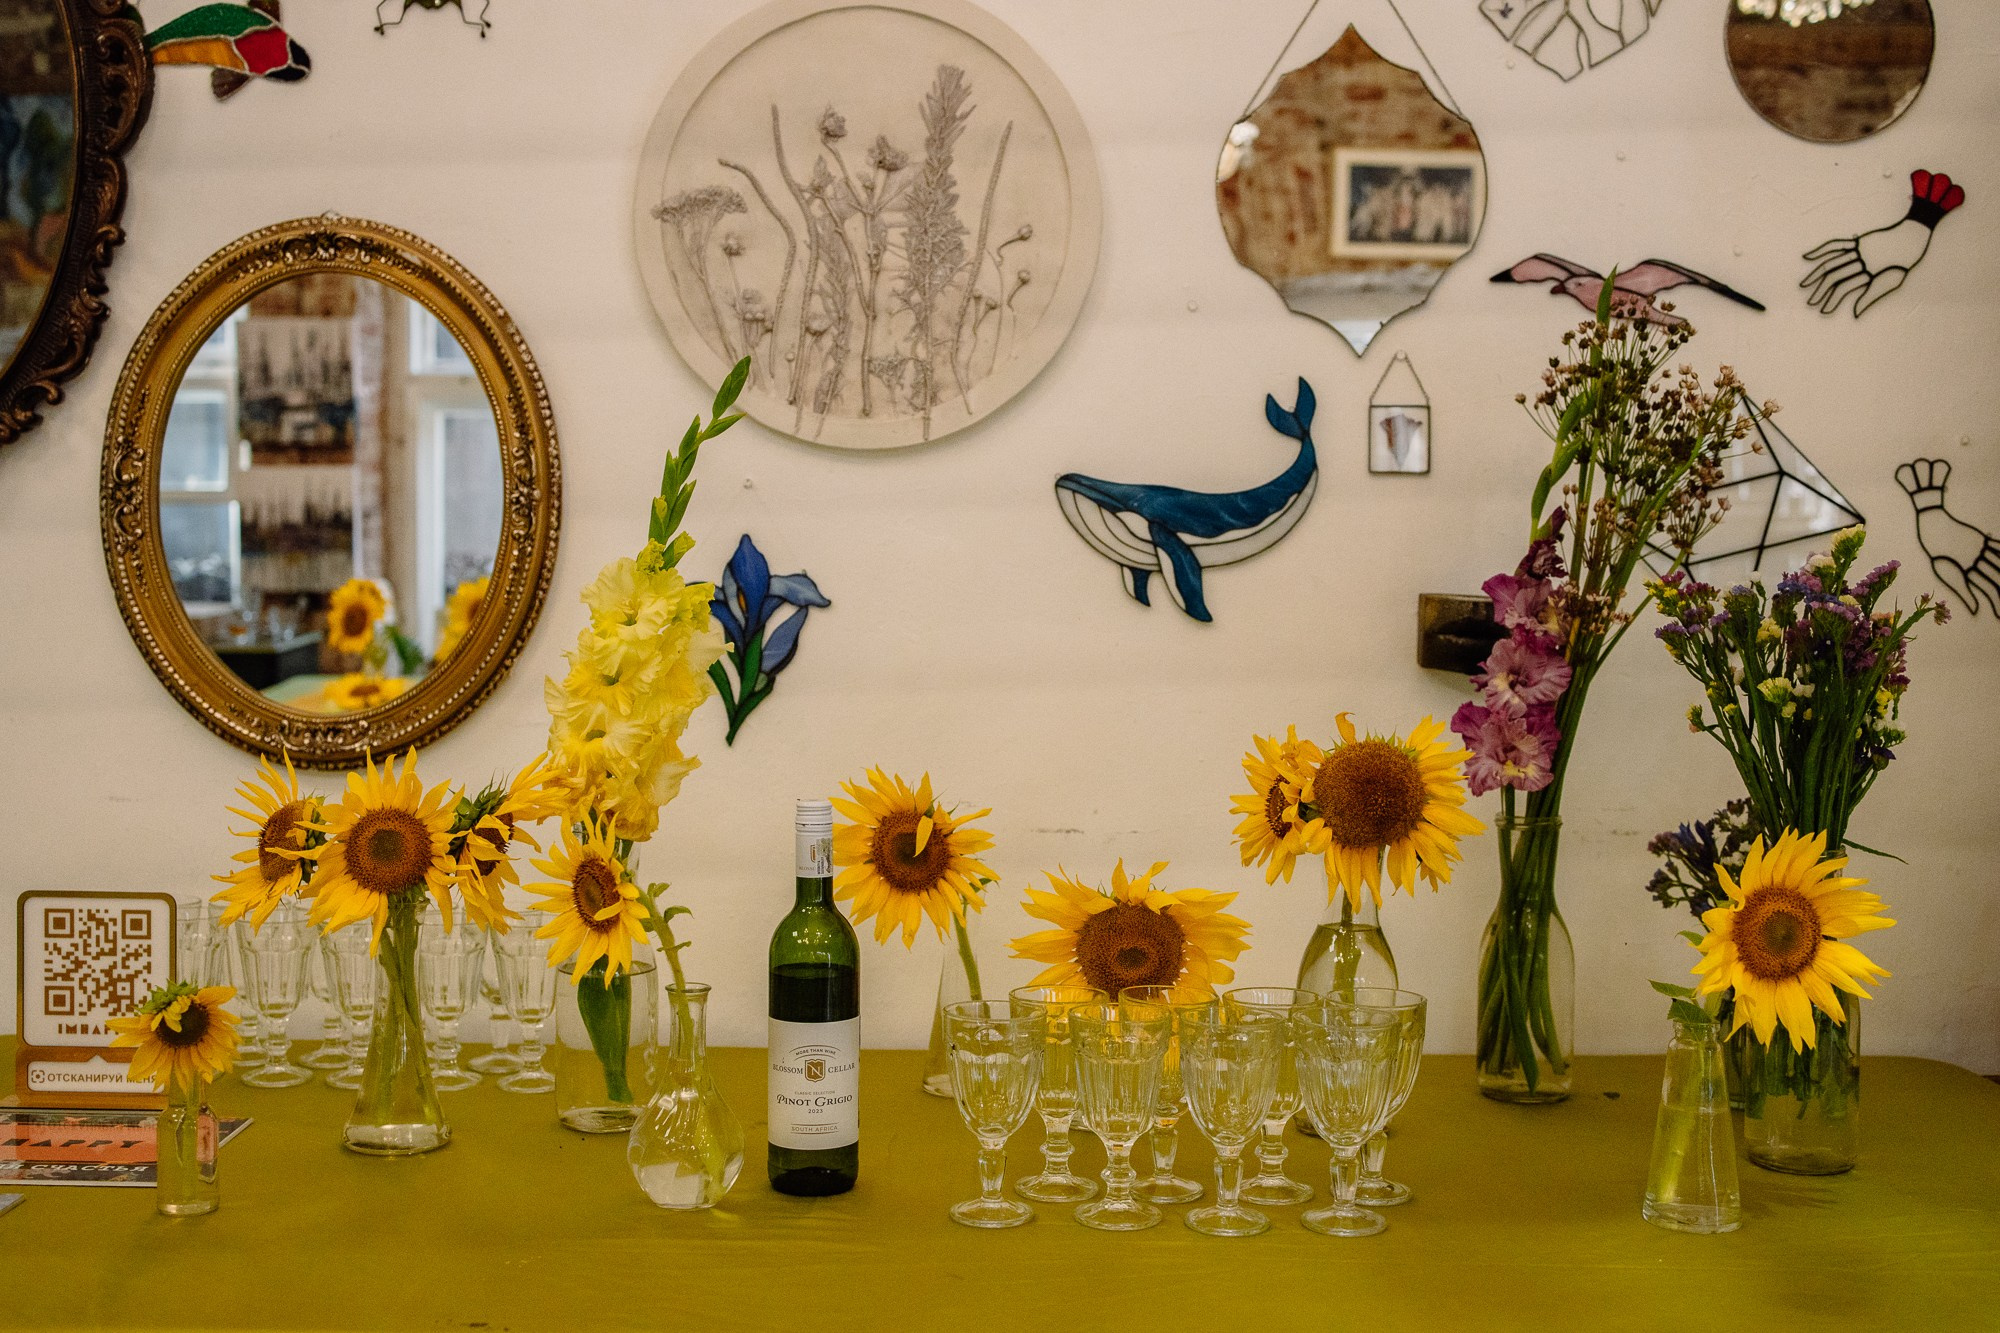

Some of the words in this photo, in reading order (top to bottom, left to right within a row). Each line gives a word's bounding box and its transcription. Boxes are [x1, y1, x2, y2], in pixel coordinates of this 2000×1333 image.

[772, 1063, 803, 1074] BLOSSOM
[827, 1062, 855, 1073] CELLAR
[47, 1073, 123, 1083] ОТСКАНИРУЙ
[776, 1094, 811, 1106] PINOT
[814, 1094, 852, 1106] GRIGIO
[30, 1163, 149, 1172] СЧАСТЬЯ
